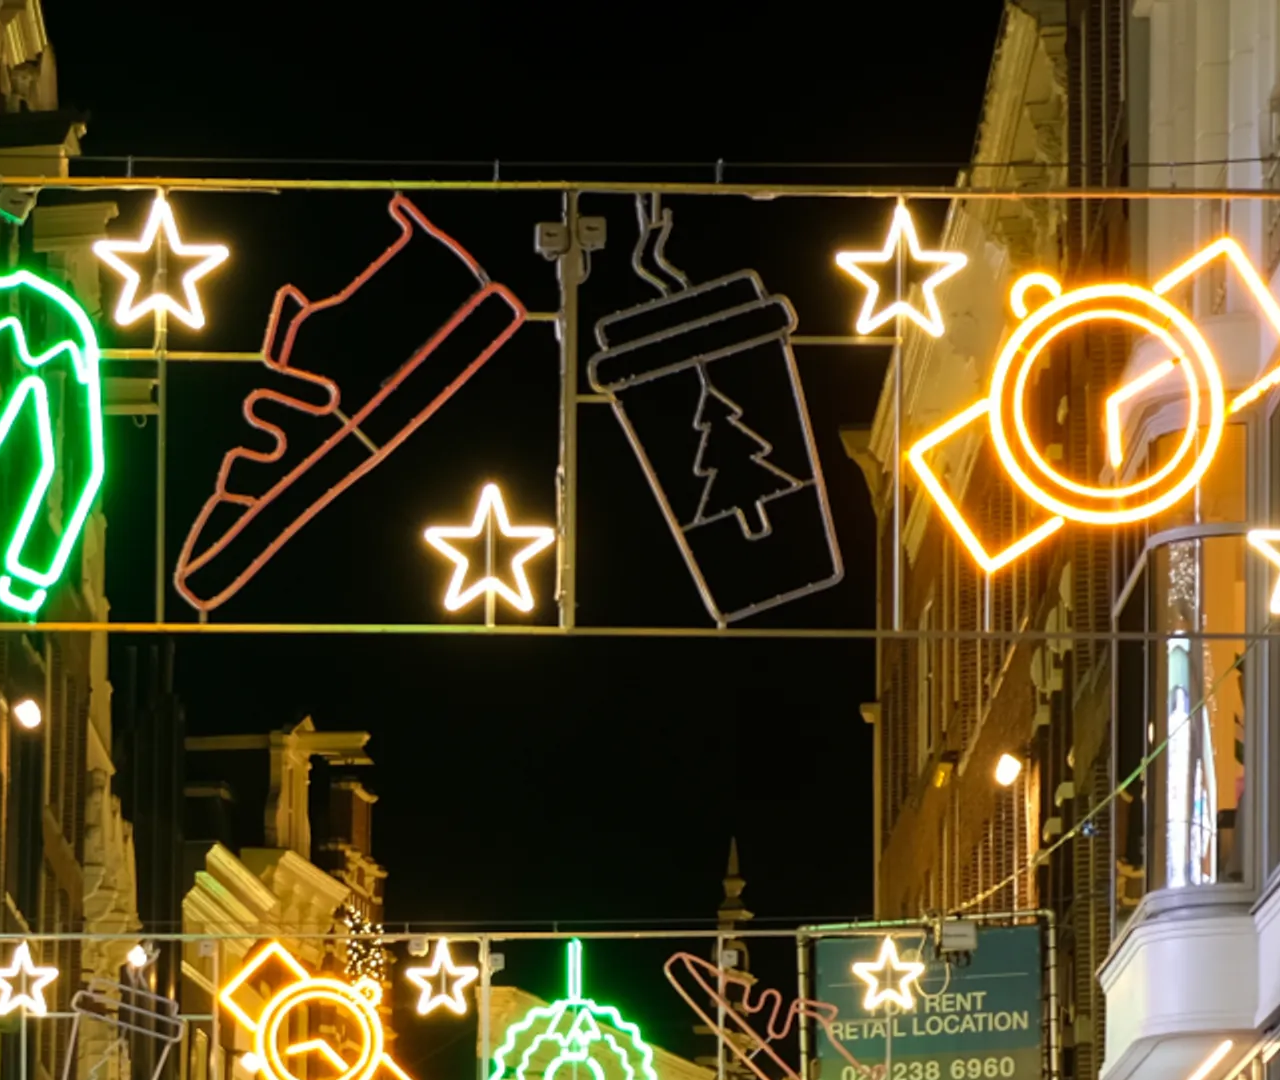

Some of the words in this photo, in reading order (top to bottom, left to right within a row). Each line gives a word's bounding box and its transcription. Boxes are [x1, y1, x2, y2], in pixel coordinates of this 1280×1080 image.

[924, 991, 987, 1014] RENT
[830, 1018, 907, 1041] RETAL
[912, 1010, 1029, 1036] LOCATION
[950, 1057, 1015, 1079] 6960
